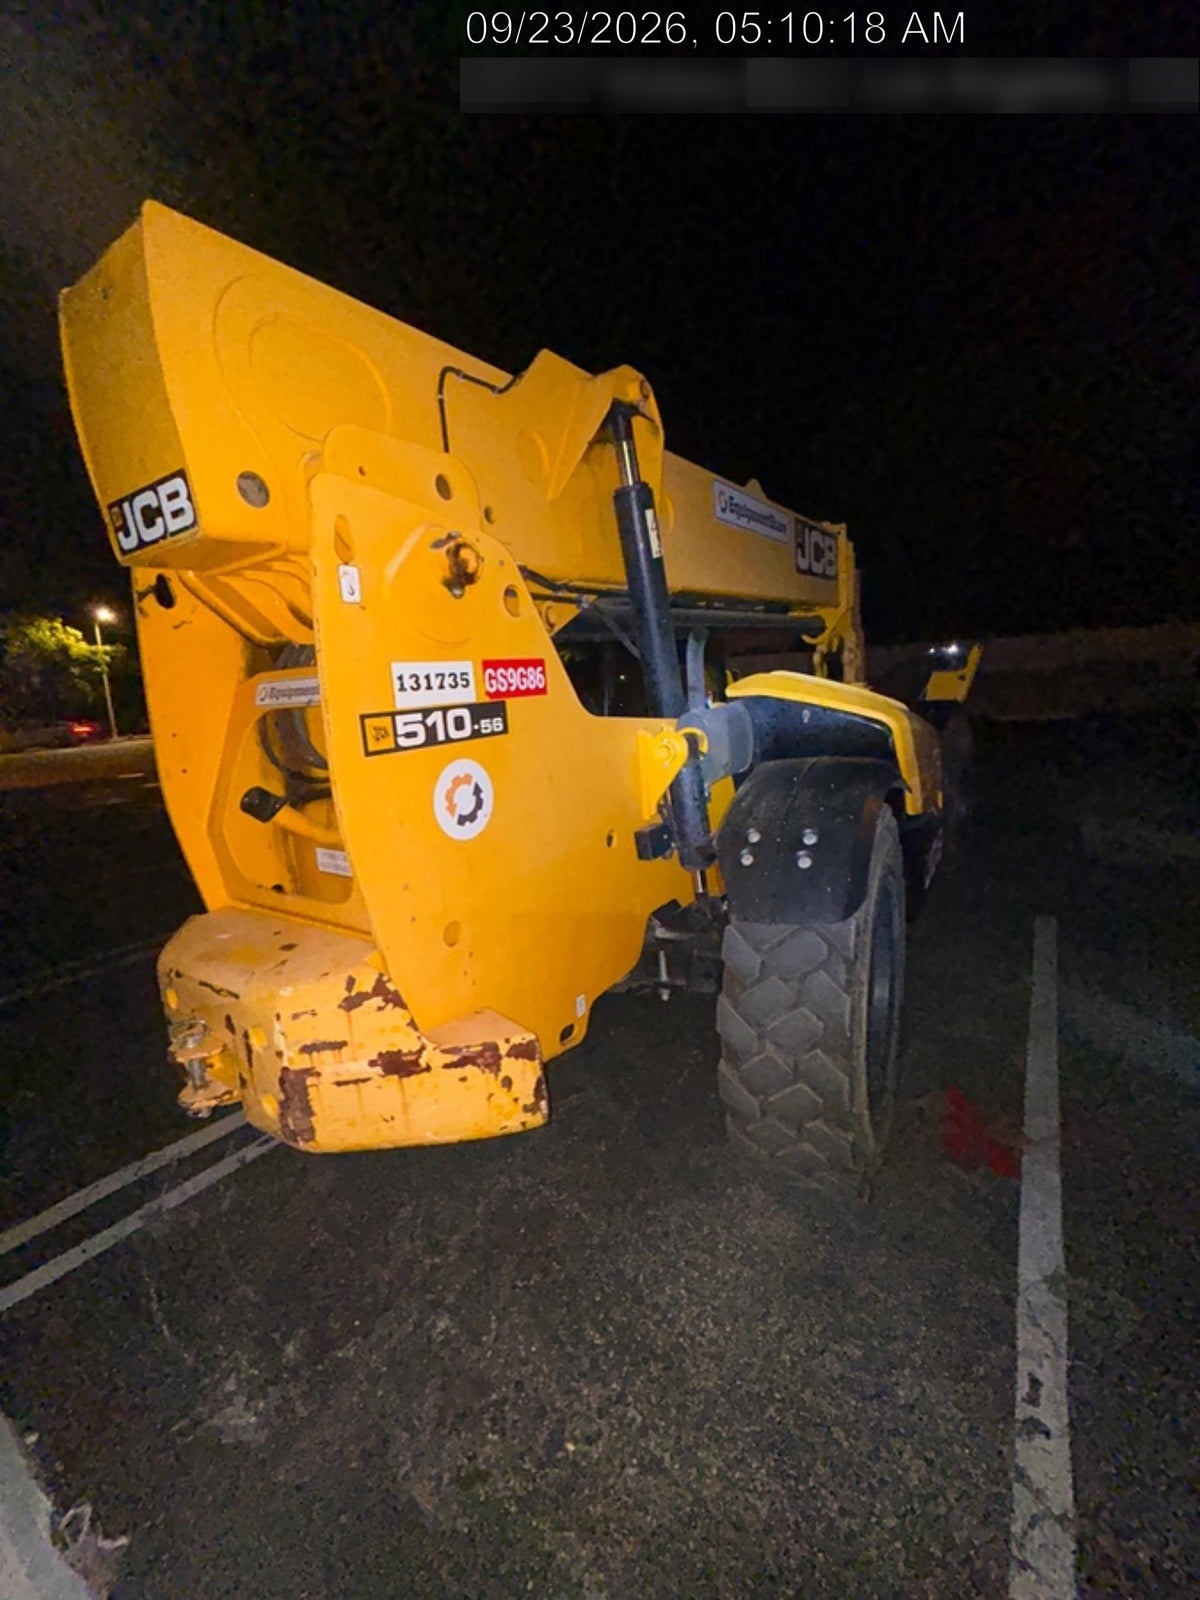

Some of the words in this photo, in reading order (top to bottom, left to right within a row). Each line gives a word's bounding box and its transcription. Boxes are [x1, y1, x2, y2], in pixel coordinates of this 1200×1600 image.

[117, 477, 195, 551] JCB
[796, 527, 836, 575] JCB
[396, 672, 471, 692] 131735
[484, 666, 545, 694] GS9G86
